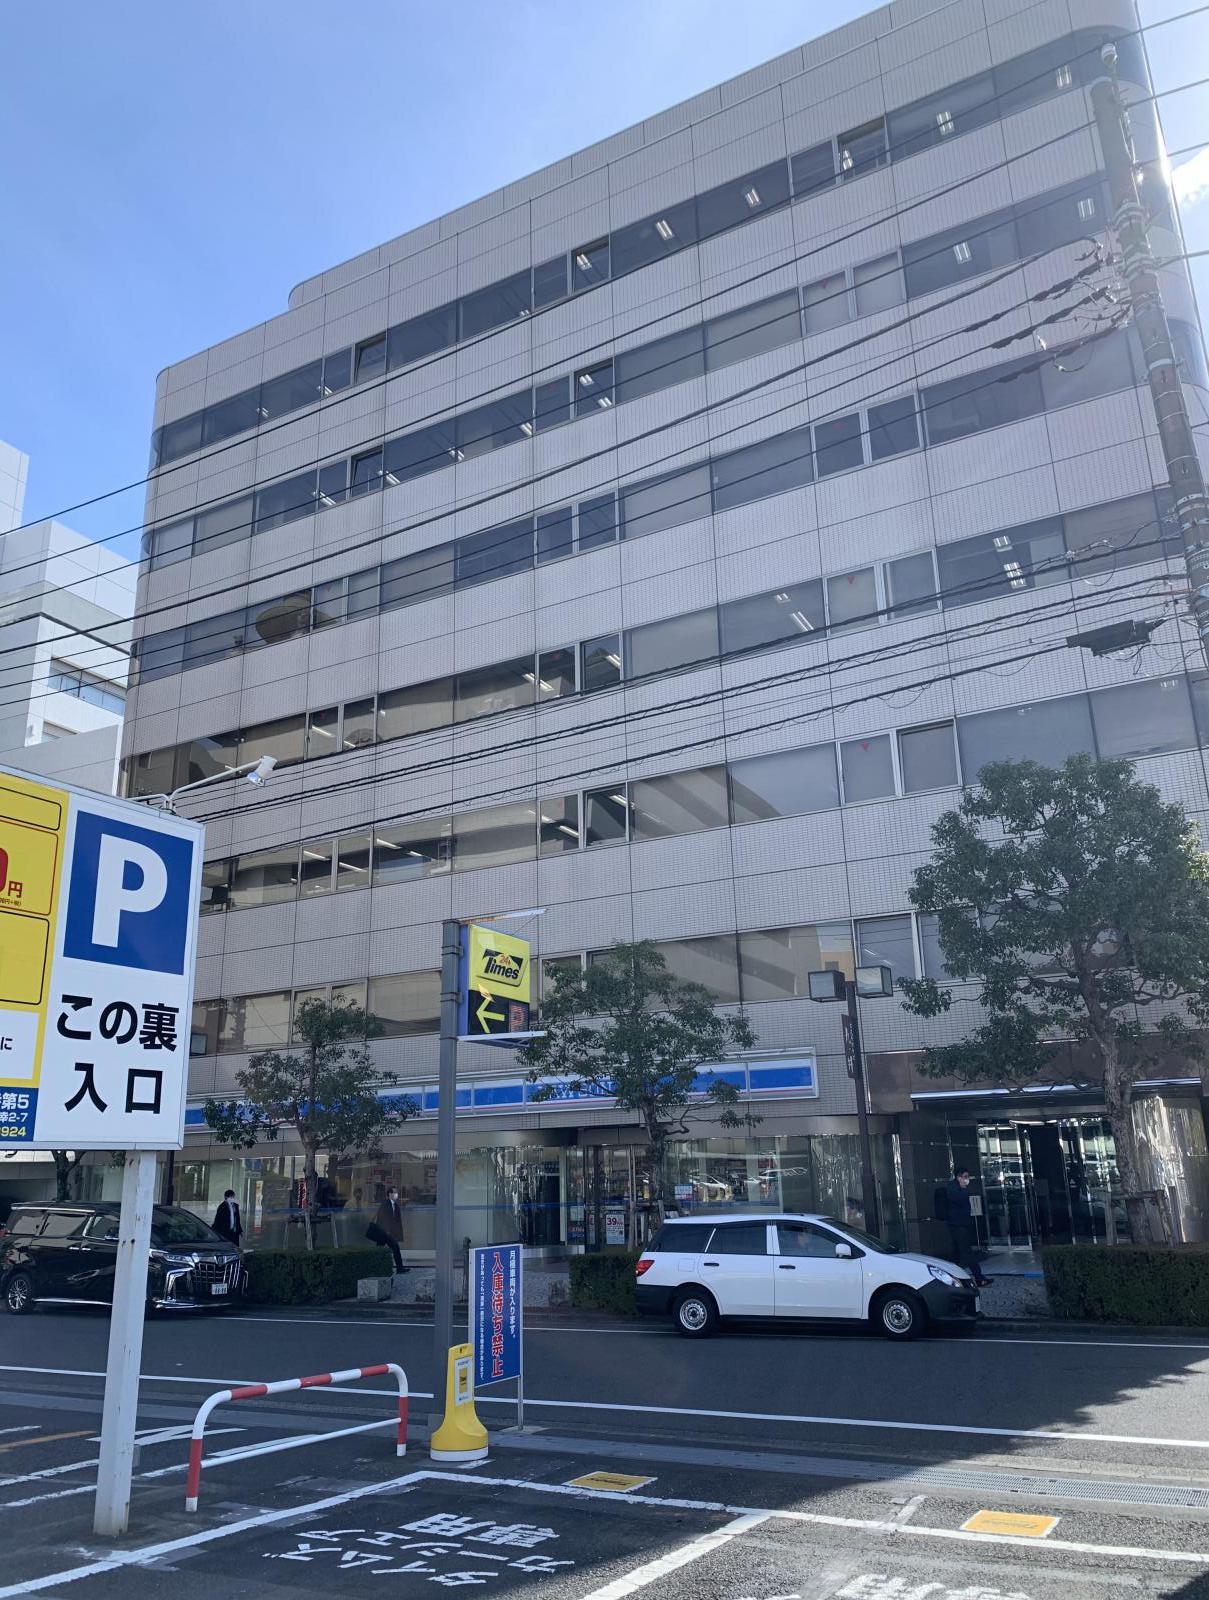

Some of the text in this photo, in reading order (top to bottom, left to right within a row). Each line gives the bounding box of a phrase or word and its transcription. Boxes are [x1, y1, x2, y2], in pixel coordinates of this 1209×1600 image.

[92, 833, 168, 948] P
[482, 949, 523, 979] Times
[57, 994, 179, 1052] この裏
[64, 1062, 163, 1114] 入口
[491, 1251, 504, 1378] 入庫待ち禁止
